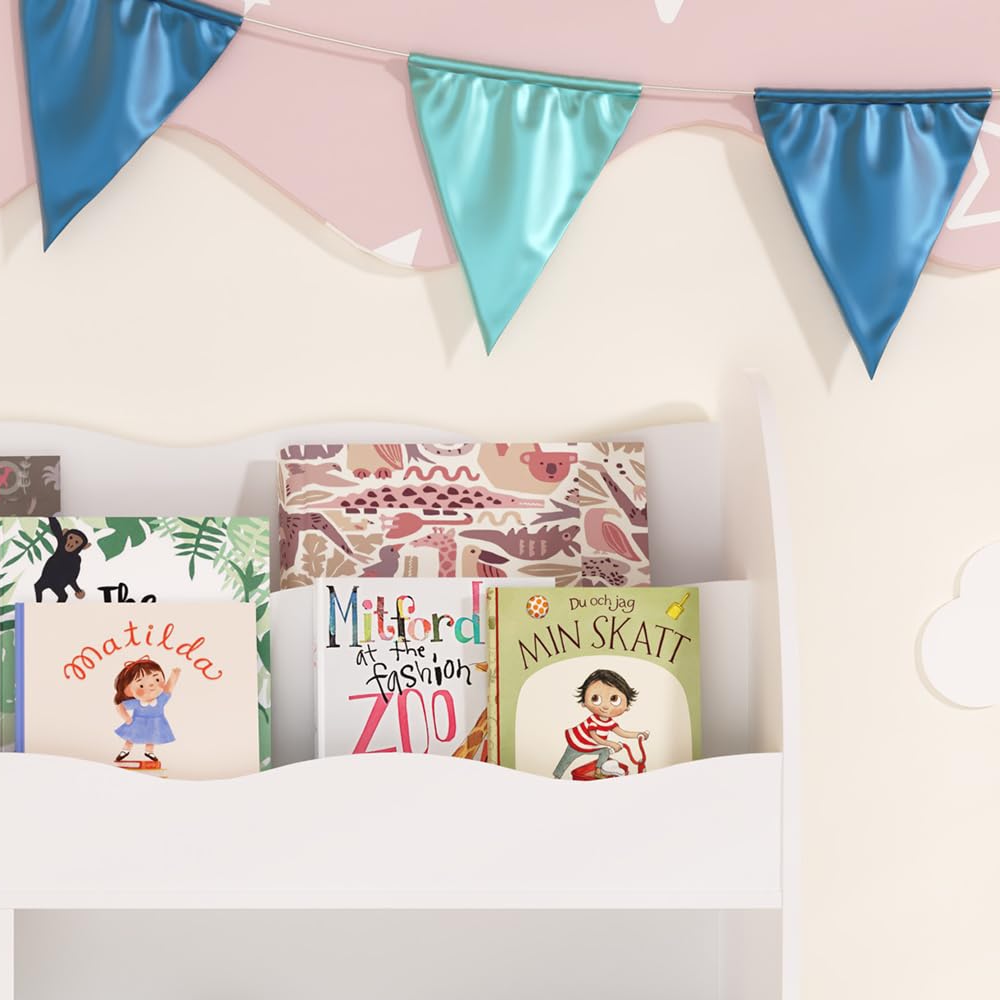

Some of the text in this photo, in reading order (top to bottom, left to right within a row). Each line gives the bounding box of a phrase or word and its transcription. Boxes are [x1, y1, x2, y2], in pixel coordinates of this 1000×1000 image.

[326, 581, 485, 648] Mitford
[569, 595, 635, 613] Du och jag
[63, 621, 223, 681] Matilda
[356, 640, 425, 666] at the
[518, 615, 691, 670] MIN SKATT
[366, 653, 472, 704] fashion
